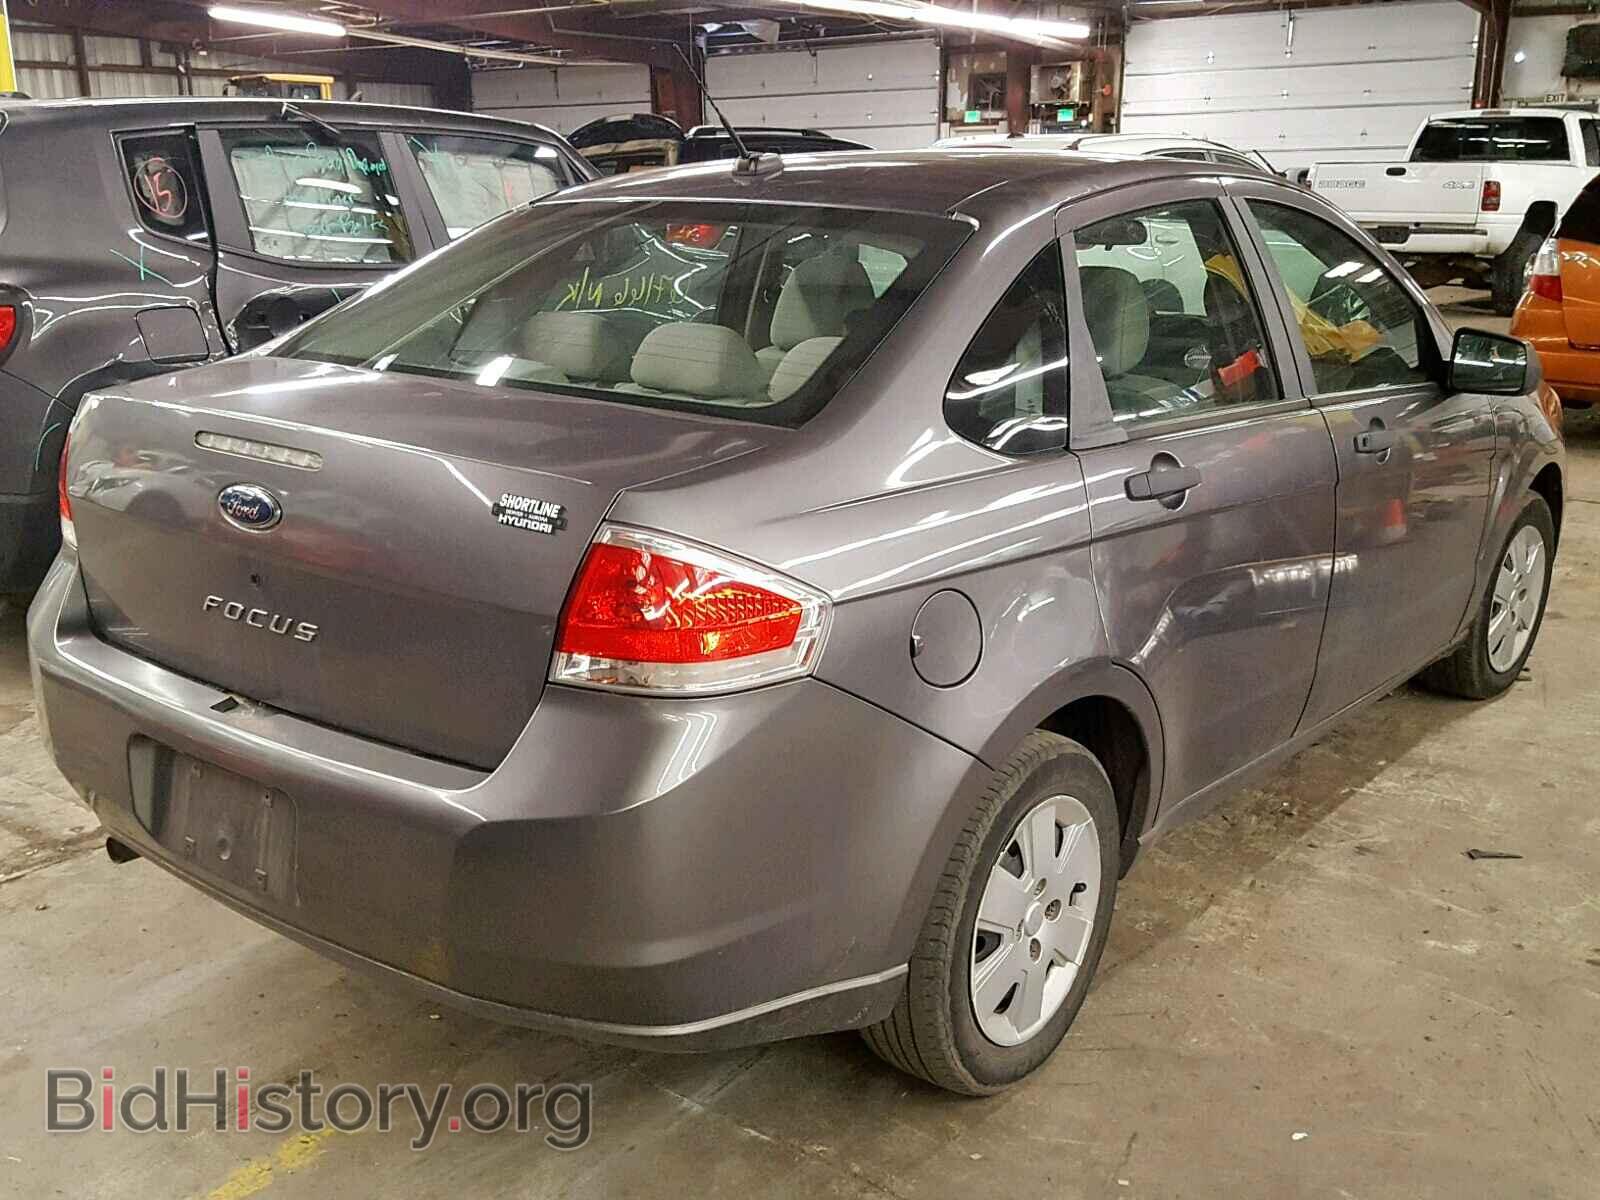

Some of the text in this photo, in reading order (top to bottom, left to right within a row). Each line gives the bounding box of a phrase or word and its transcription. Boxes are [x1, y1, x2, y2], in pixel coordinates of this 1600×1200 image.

[226, 492, 261, 520] Ford
[499, 493, 561, 519] SHORTLINE
[498, 513, 553, 534] HYUNDAI
[203, 594, 319, 642] FOCUS
